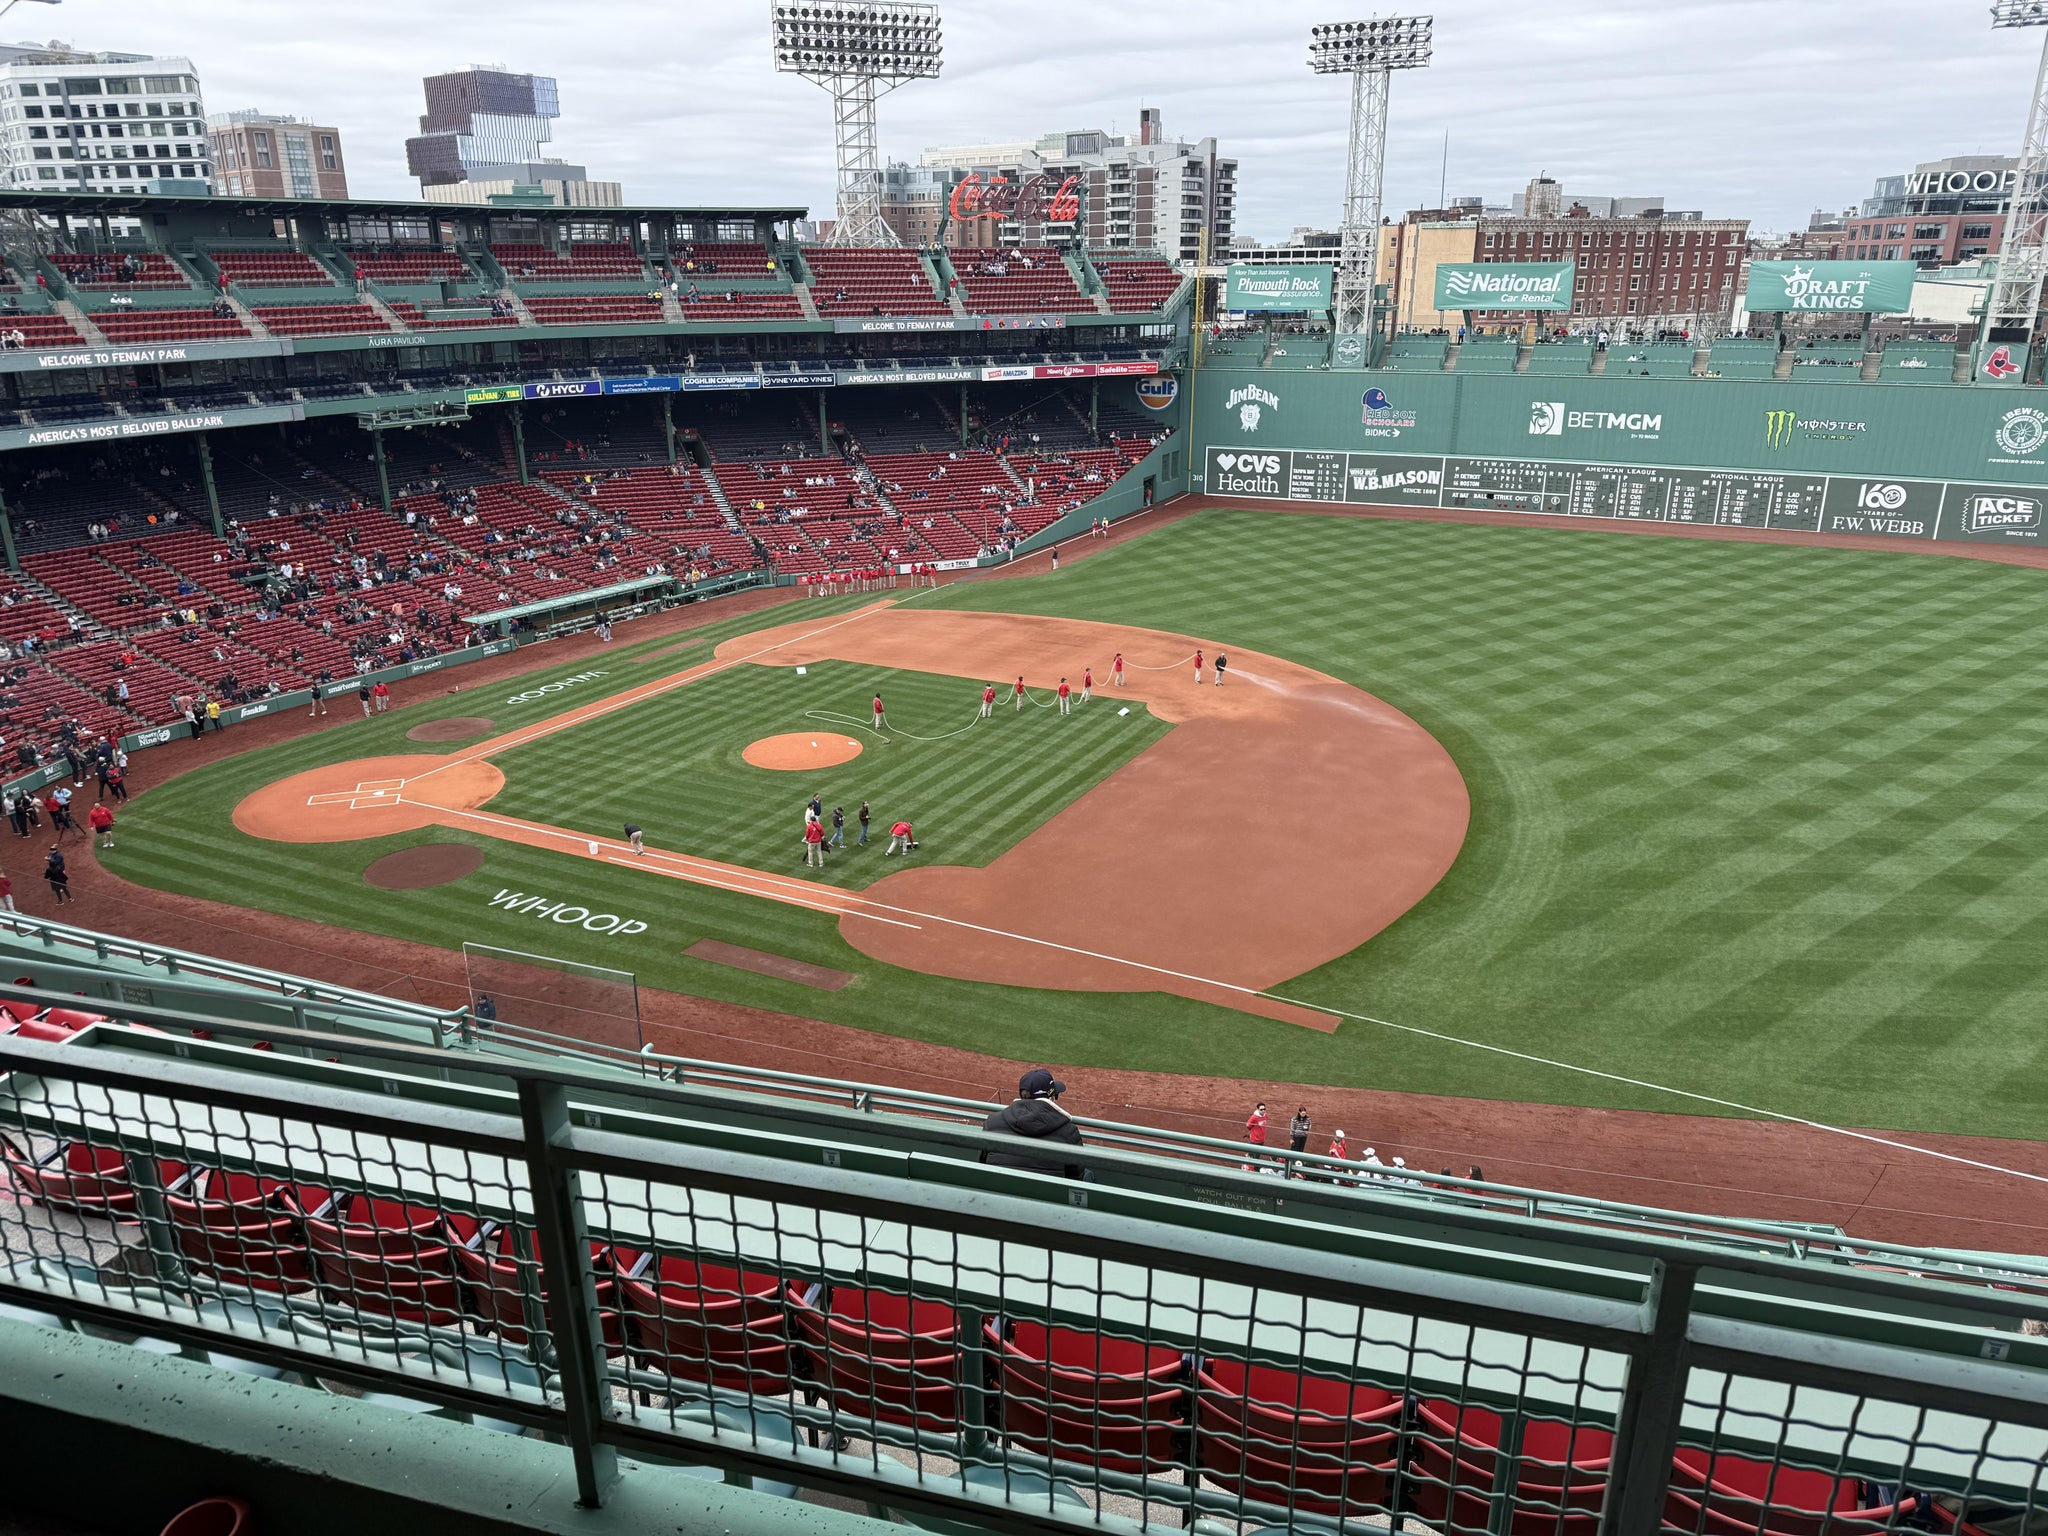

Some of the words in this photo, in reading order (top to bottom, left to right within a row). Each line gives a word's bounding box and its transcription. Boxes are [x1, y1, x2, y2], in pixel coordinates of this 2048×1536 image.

[991, 176, 1008, 184] ENJOY
[1904, 170, 2018, 194] WHOOP
[949, 174, 1085, 220] Coca-Cola
[1238, 277, 1289, 292] Plymouth
[1292, 277, 1320, 291] Rock
[1785, 280, 1870, 297] DRAFT
[1501, 294, 1518, 302] Car
[1522, 294, 1555, 302] Rental
[1793, 294, 1864, 309] KINGS
[394, 336, 426, 345] PAVILION
[39, 355, 91, 367] WELCOME
[95, 354, 109, 365] TO
[112, 351, 155, 363] FENWAY
[159, 349, 186, 360] PARK
[717, 376, 758, 384] COMPANIES
[848, 374, 884, 383] AMERICA'S
[886, 373, 904, 381] MOST
[938, 371, 972, 380] BALLPARK
[552, 384, 585, 395] HYCU
[1137, 381, 1175, 395] Gulf
[468, 390, 498, 402] SULLIVAN
[507, 390, 520, 399] TIRE
[1367, 410, 1390, 419] RED
[1392, 410, 1416, 420] SOX
[1568, 411, 1662, 431] BETMGM
[2001, 407, 2032, 421] IBEW
[29, 429, 87, 444] AMERICA'S
[91, 425, 120, 438] MOST
[123, 421, 170, 435] BELOVED
[172, 416, 224, 430] BALLPARK
[1366, 419, 1415, 428] SCHOLARS
[1365, 428, 1391, 438] BIDMC
[1237, 454, 1281, 474] CVS
[1470, 460, 1512, 468] FENWAY
[1585, 466, 1624, 474] AMERICAN
[1192, 474, 1203, 482] 310
[1218, 473, 1280, 493] Health
[1710, 473, 1750, 481] NATIONAL
[1752, 475, 1784, 483] LEAGUE
[1857, 483, 1907, 509] 160
[1978, 498, 2034, 514] ACE
[1832, 516, 1864, 531] F.W.
[1869, 518, 1924, 535] WEBB
[1978, 515, 2032, 525] TICKET
[423, 661, 442, 671] TICKET
[328, 680, 361, 694] smartwater
[507, 671, 610, 705] WHOOP
[240, 704, 268, 719] Franklin
[488, 888, 648, 936] WHOOP
[1193, 1187, 1223, 1197] WATCH
[1225, 1193, 1245, 1201] OUT
[1247, 1196, 1266, 1205] FOR
